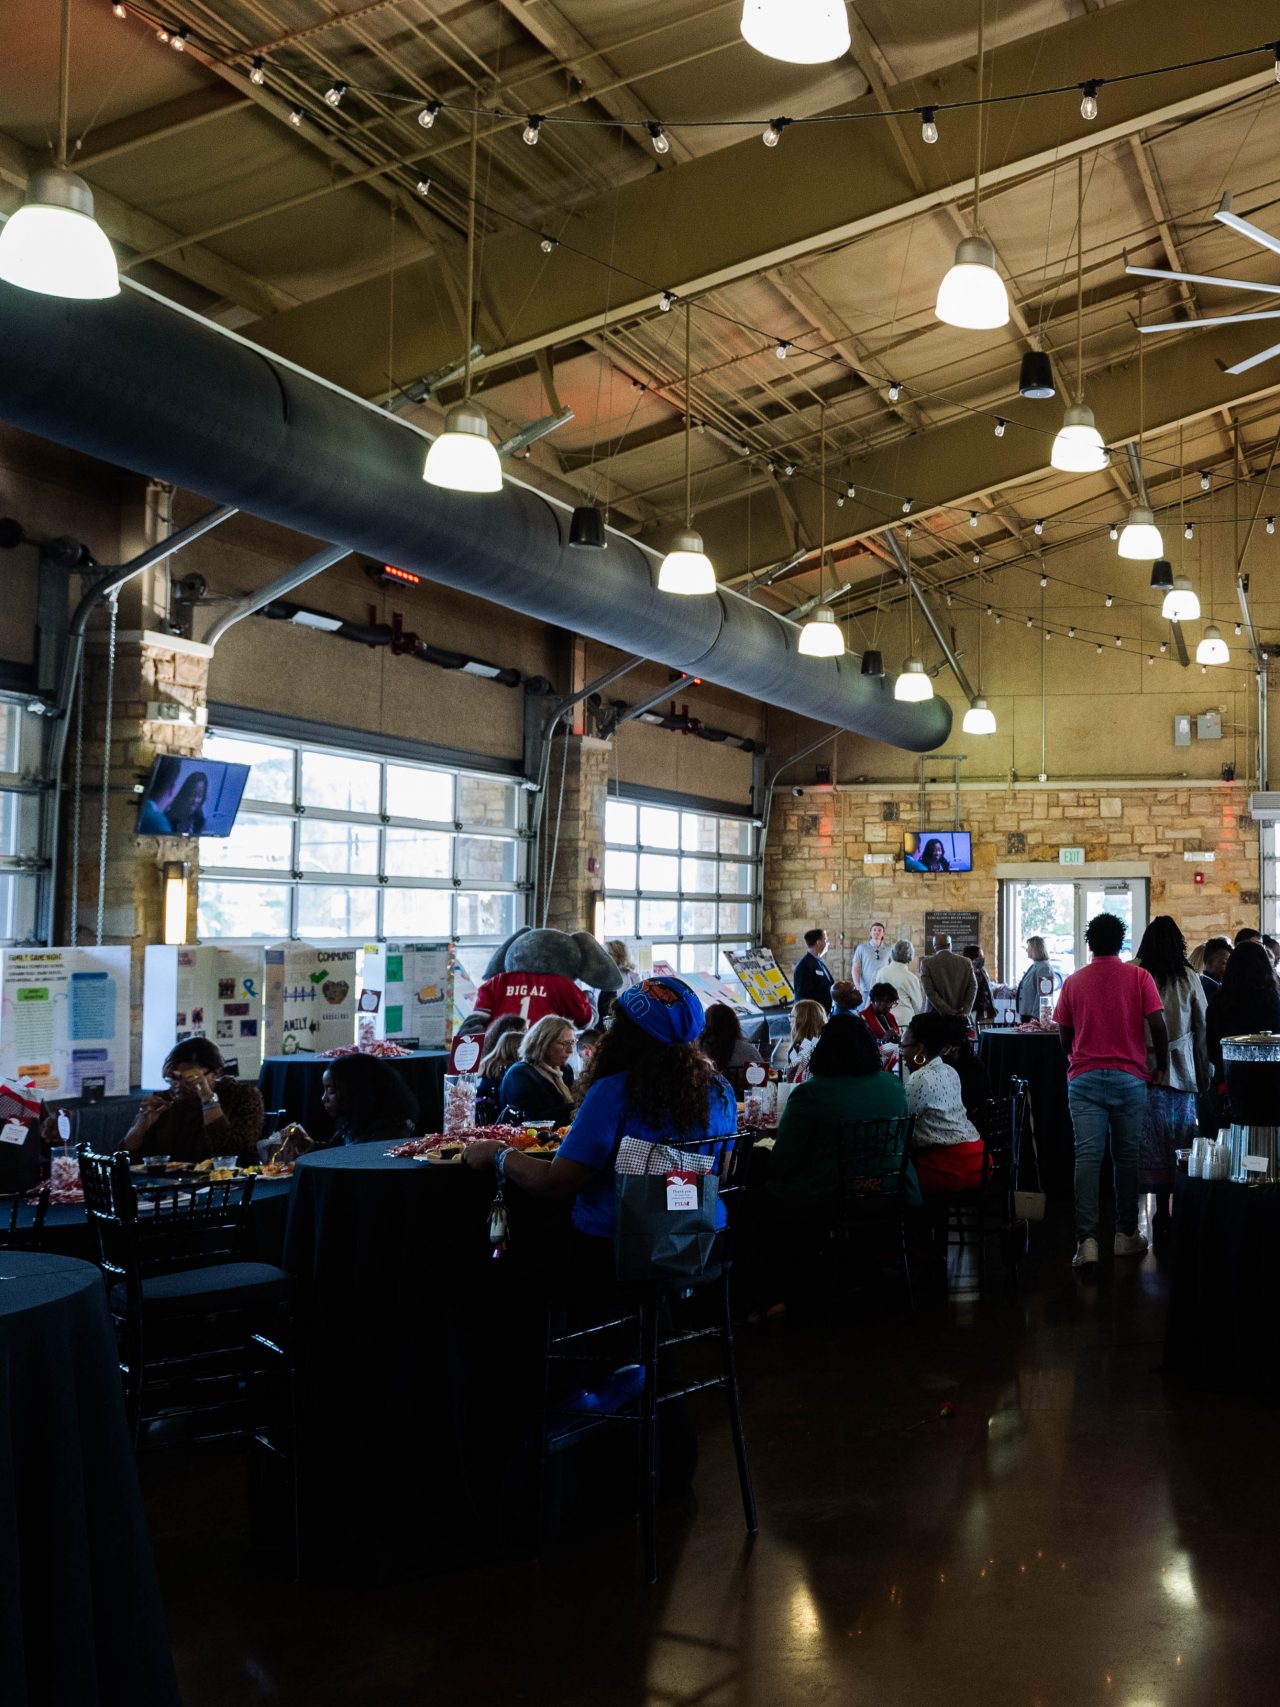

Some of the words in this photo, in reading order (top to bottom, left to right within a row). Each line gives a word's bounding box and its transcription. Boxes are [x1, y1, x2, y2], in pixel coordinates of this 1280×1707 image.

[1063, 850, 1081, 863] EXIT
[506, 984, 528, 996] BIG
[530, 986, 547, 997] AL
